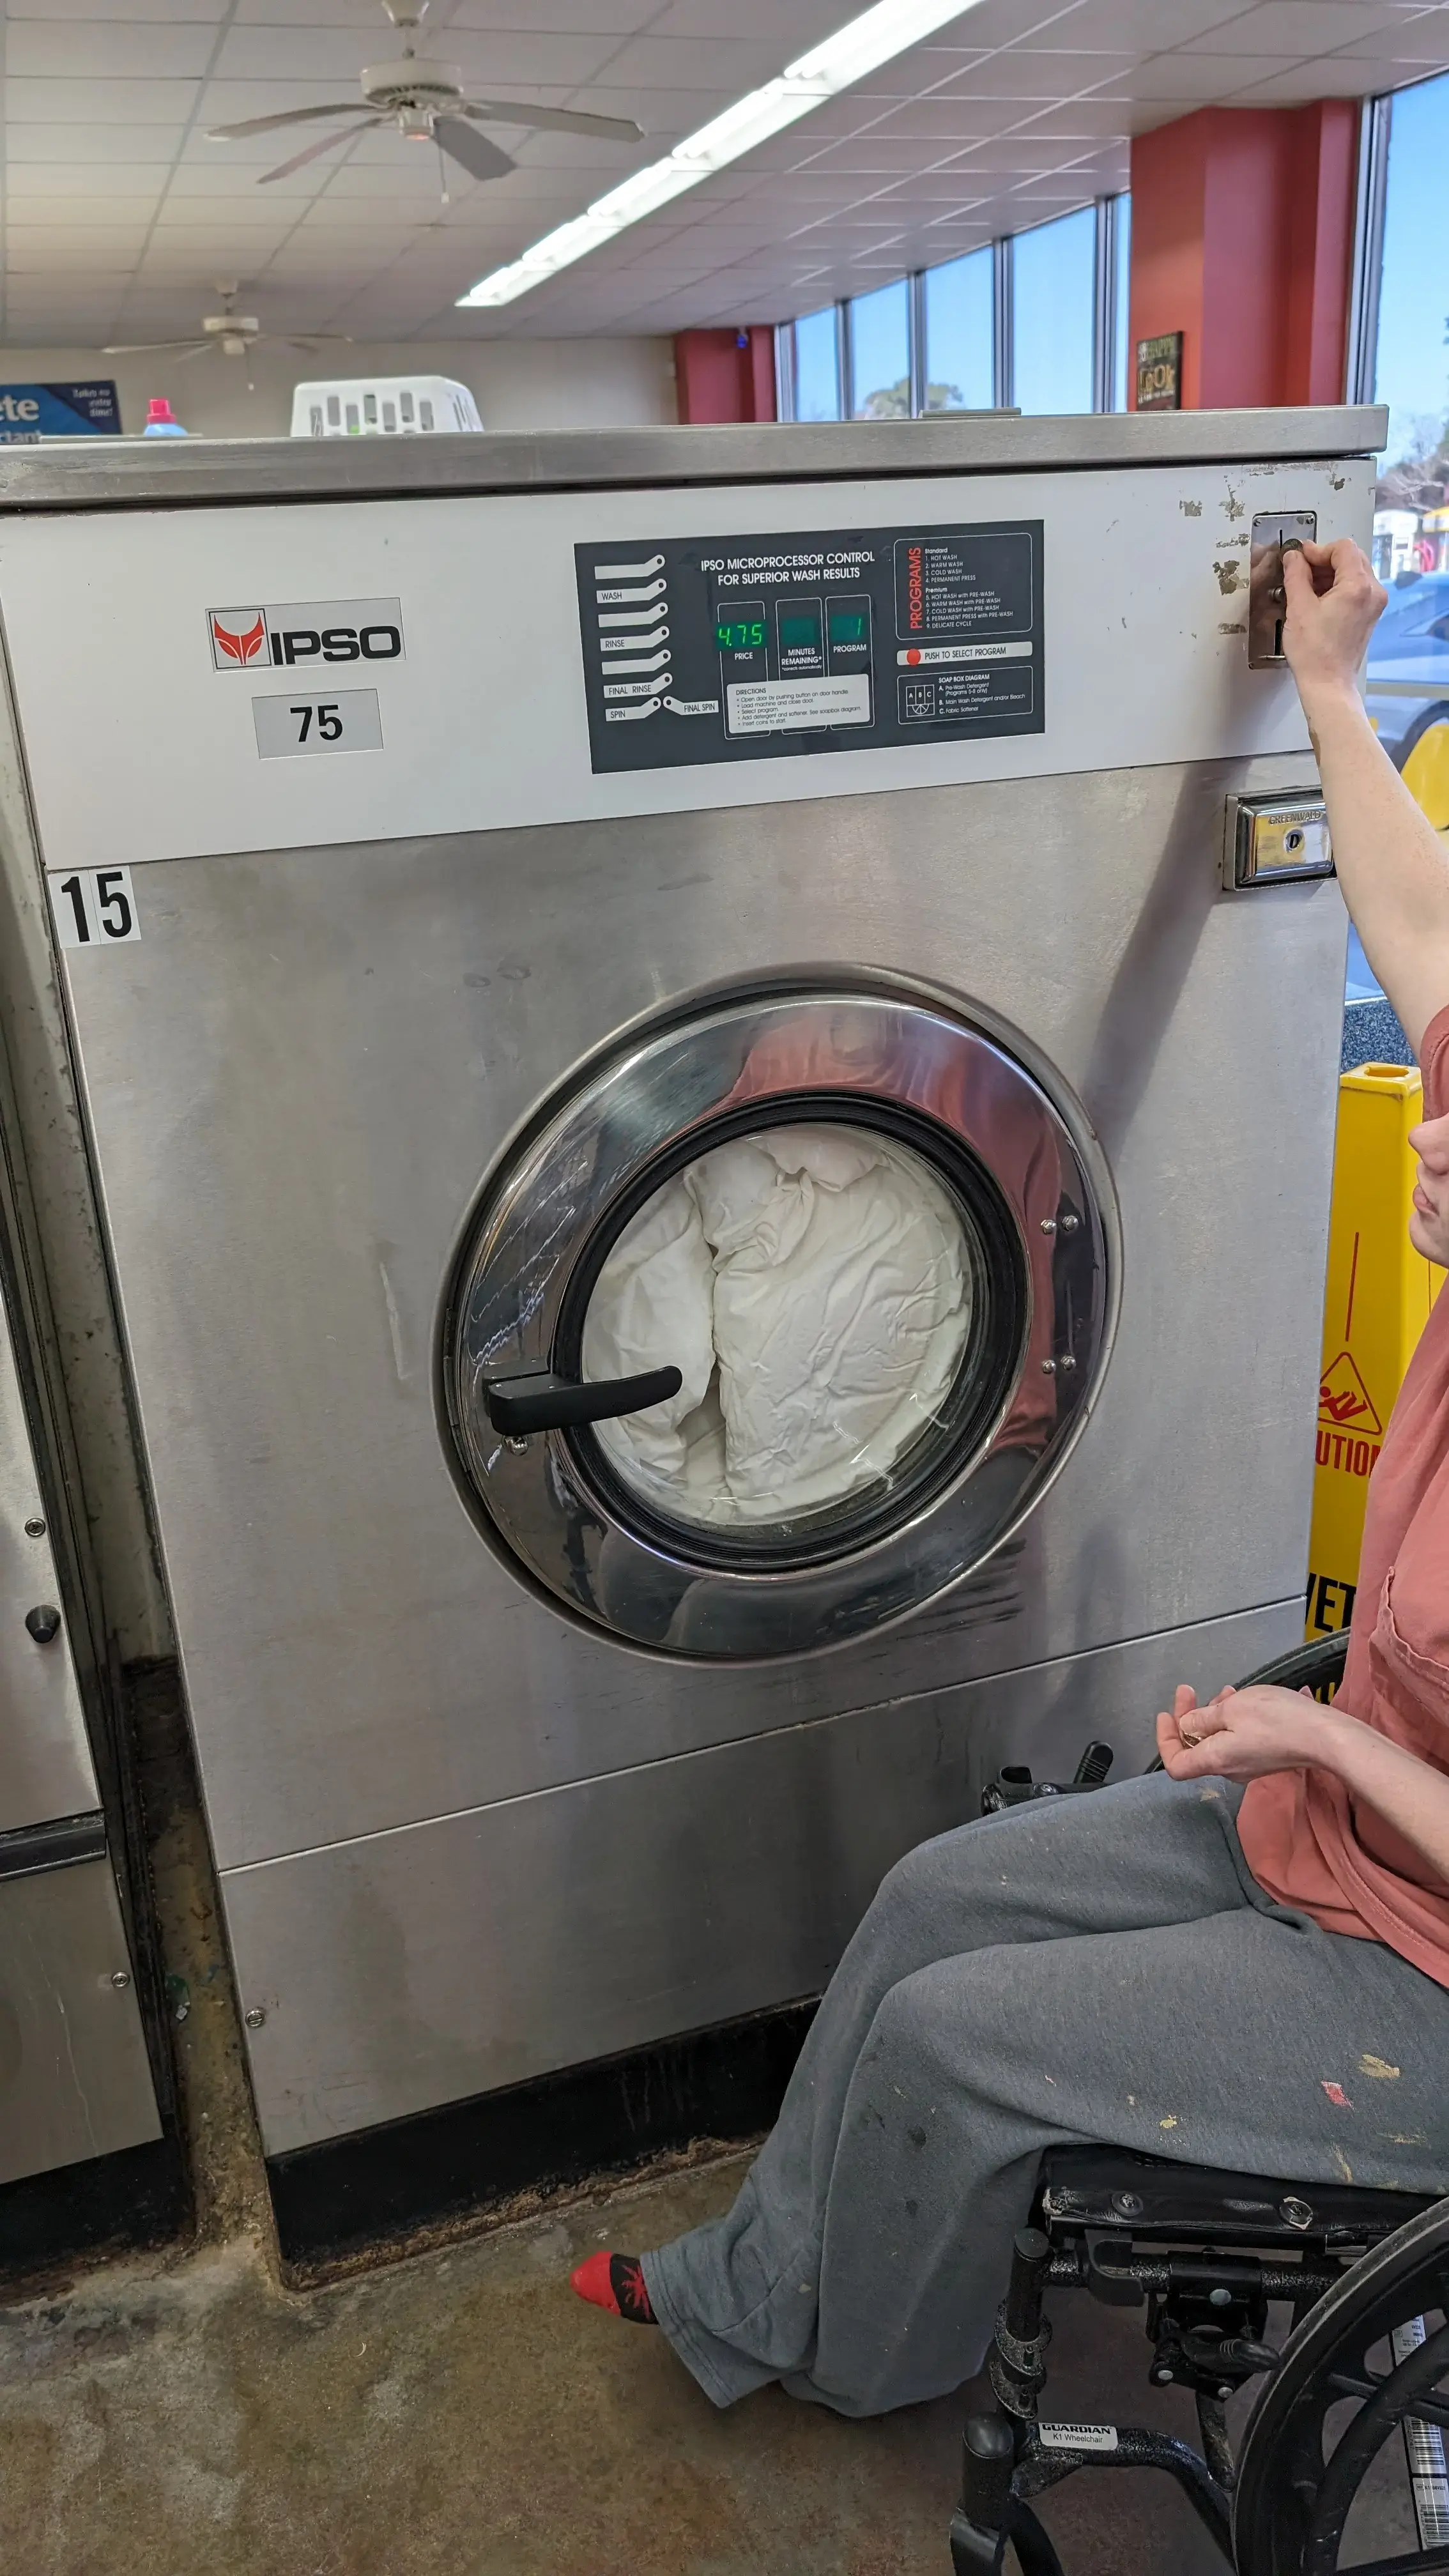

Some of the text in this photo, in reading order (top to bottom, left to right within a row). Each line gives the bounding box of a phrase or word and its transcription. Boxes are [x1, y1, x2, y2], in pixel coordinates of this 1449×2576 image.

[0, 394, 40, 422] te
[701, 551, 875, 572] IPSO MICROPROCESSOR CONTROL
[718, 567, 860, 586] FOR SUPERIOR WASH RESULTS
[908, 547, 922, 629] PROGRAMS
[601, 592, 622, 601] WASH
[857, 618, 861, 636] 1
[719, 624, 762, 647] 4.75
[270, 625, 401, 666] IPSO
[605, 640, 625, 648] RINSE
[833, 644, 867, 653] PROGRAM
[735, 652, 753, 660] PRICE
[788, 647, 815, 656] MINUTES
[953, 649, 972, 658] SELECT
[975, 647, 1006, 656] PROGRAM
[608, 684, 652, 695] FINAL RINSE
[610, 710, 625, 718] SPIN
[684, 704, 700, 712] FINAL
[290, 704, 343, 742] 75
[1268, 811, 1321, 825] GREENWALD
[61, 871, 132, 942] 15
[1042, 2424, 1110, 2434] GUARDIAN
[1064, 2433, 1103, 2443] Wheelchair
